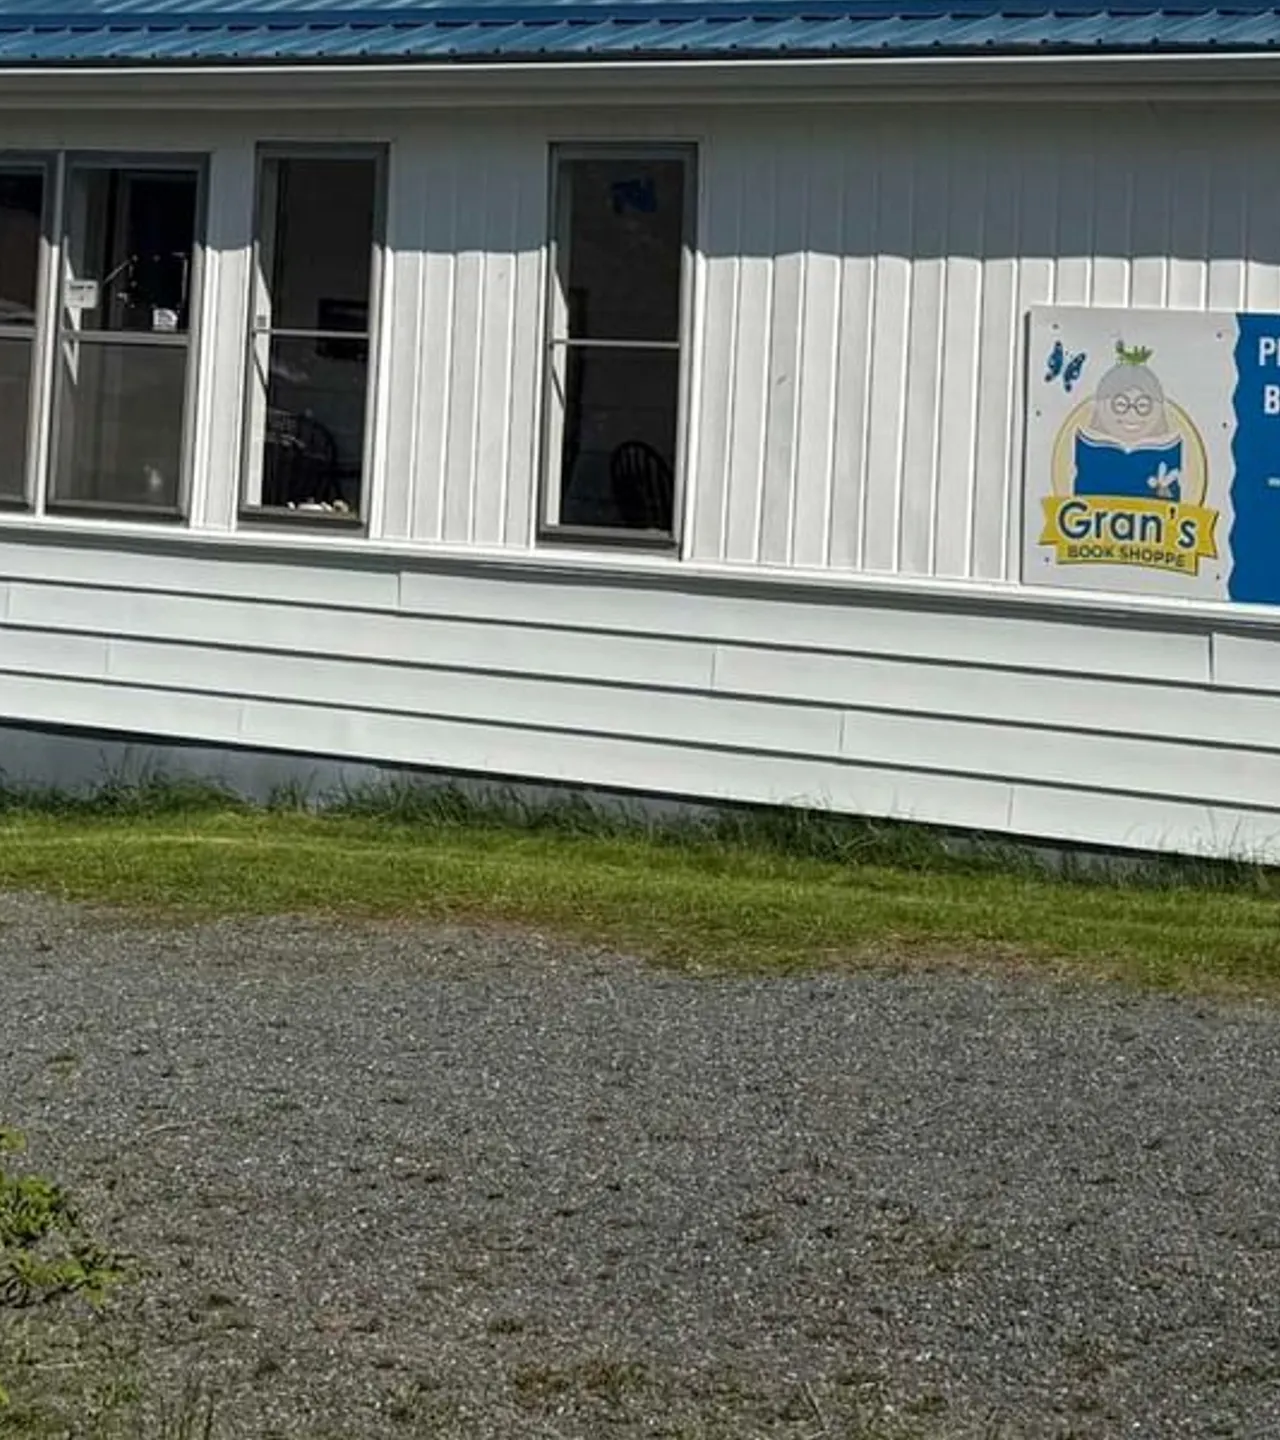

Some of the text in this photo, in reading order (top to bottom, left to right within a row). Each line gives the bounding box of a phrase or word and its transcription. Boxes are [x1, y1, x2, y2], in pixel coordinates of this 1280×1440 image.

[1057, 501, 1197, 550] Gran's
[1067, 543, 1188, 568] BOOK SHOPPE
